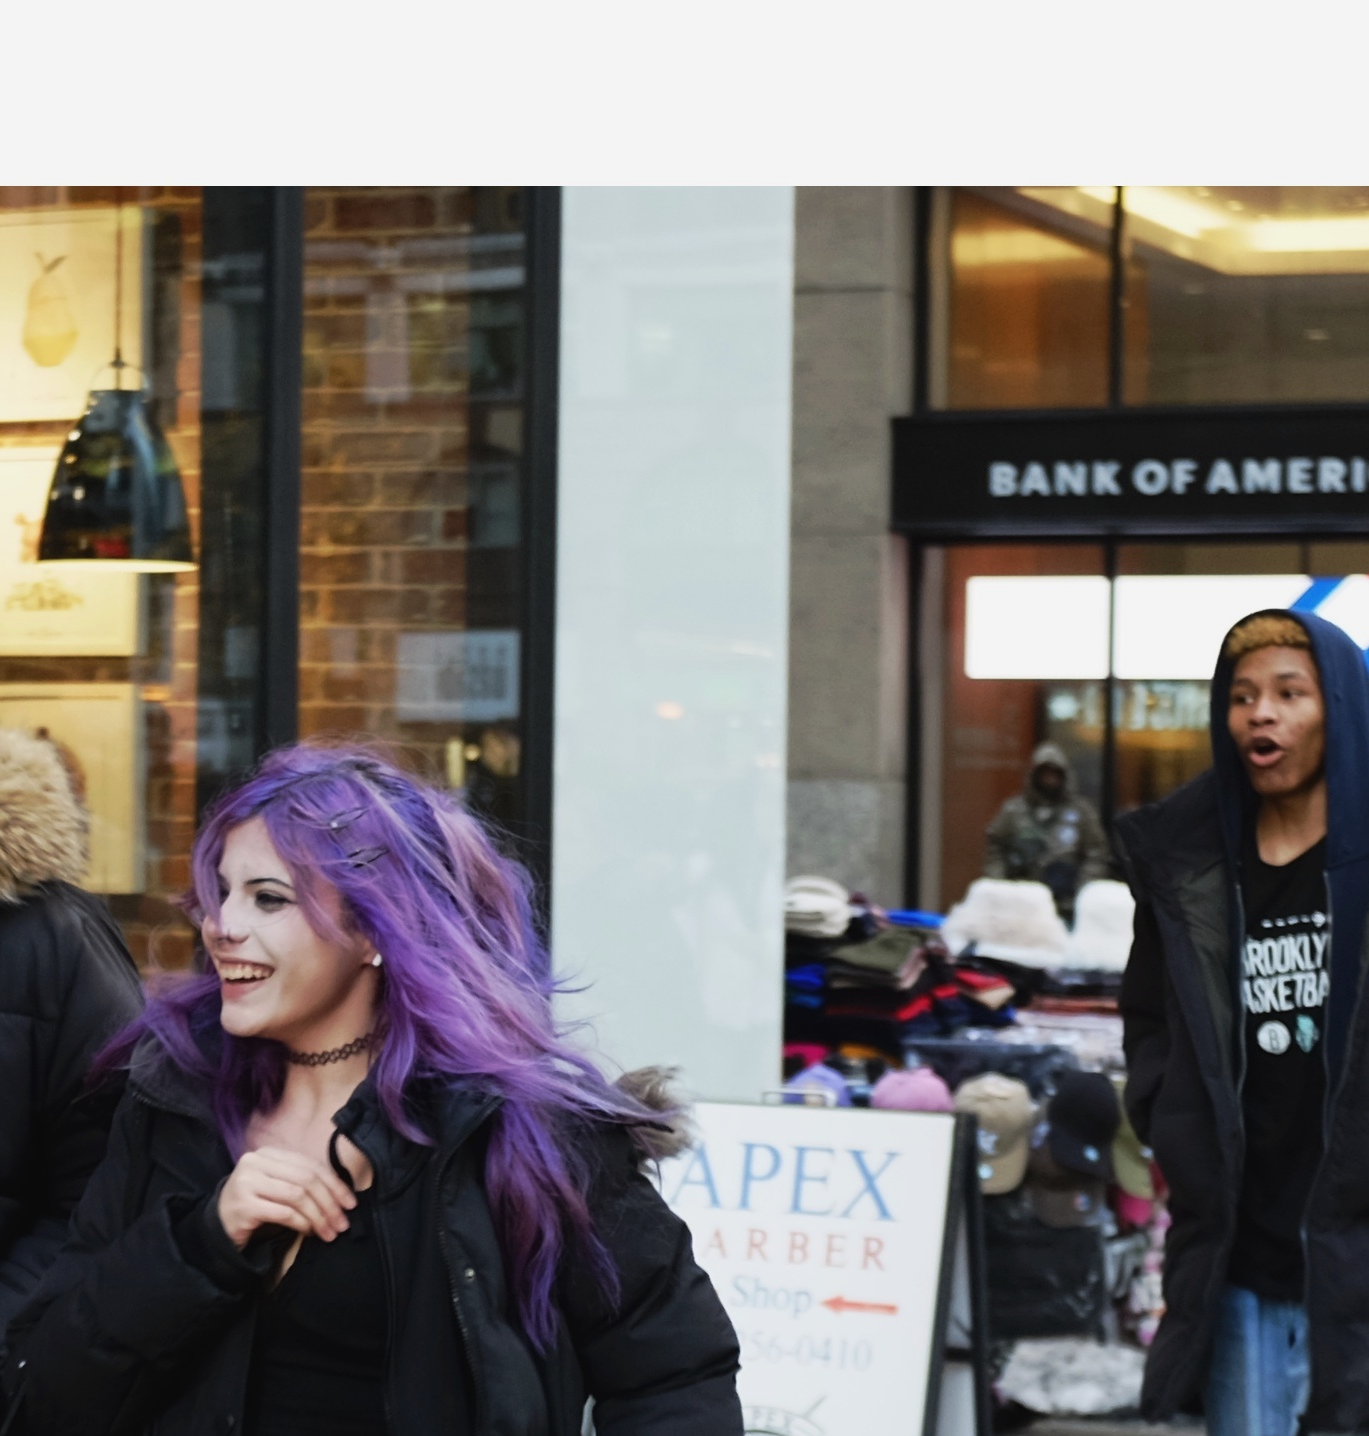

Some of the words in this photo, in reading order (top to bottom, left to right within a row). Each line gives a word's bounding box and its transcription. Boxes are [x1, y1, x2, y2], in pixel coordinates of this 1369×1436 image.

[988, 461, 1122, 496] BANK
[1132, 459, 1198, 495] OF
[1242, 932, 1331, 976] ROOKLY
[1241, 970, 1330, 1014] ASKETBA
[670, 1140, 901, 1222] APEX
[704, 1227, 886, 1271] ARBER
[731, 1274, 813, 1319] Shop
[736, 1328, 874, 1373] 56-0410
[751, 1408, 793, 1434] PEX
